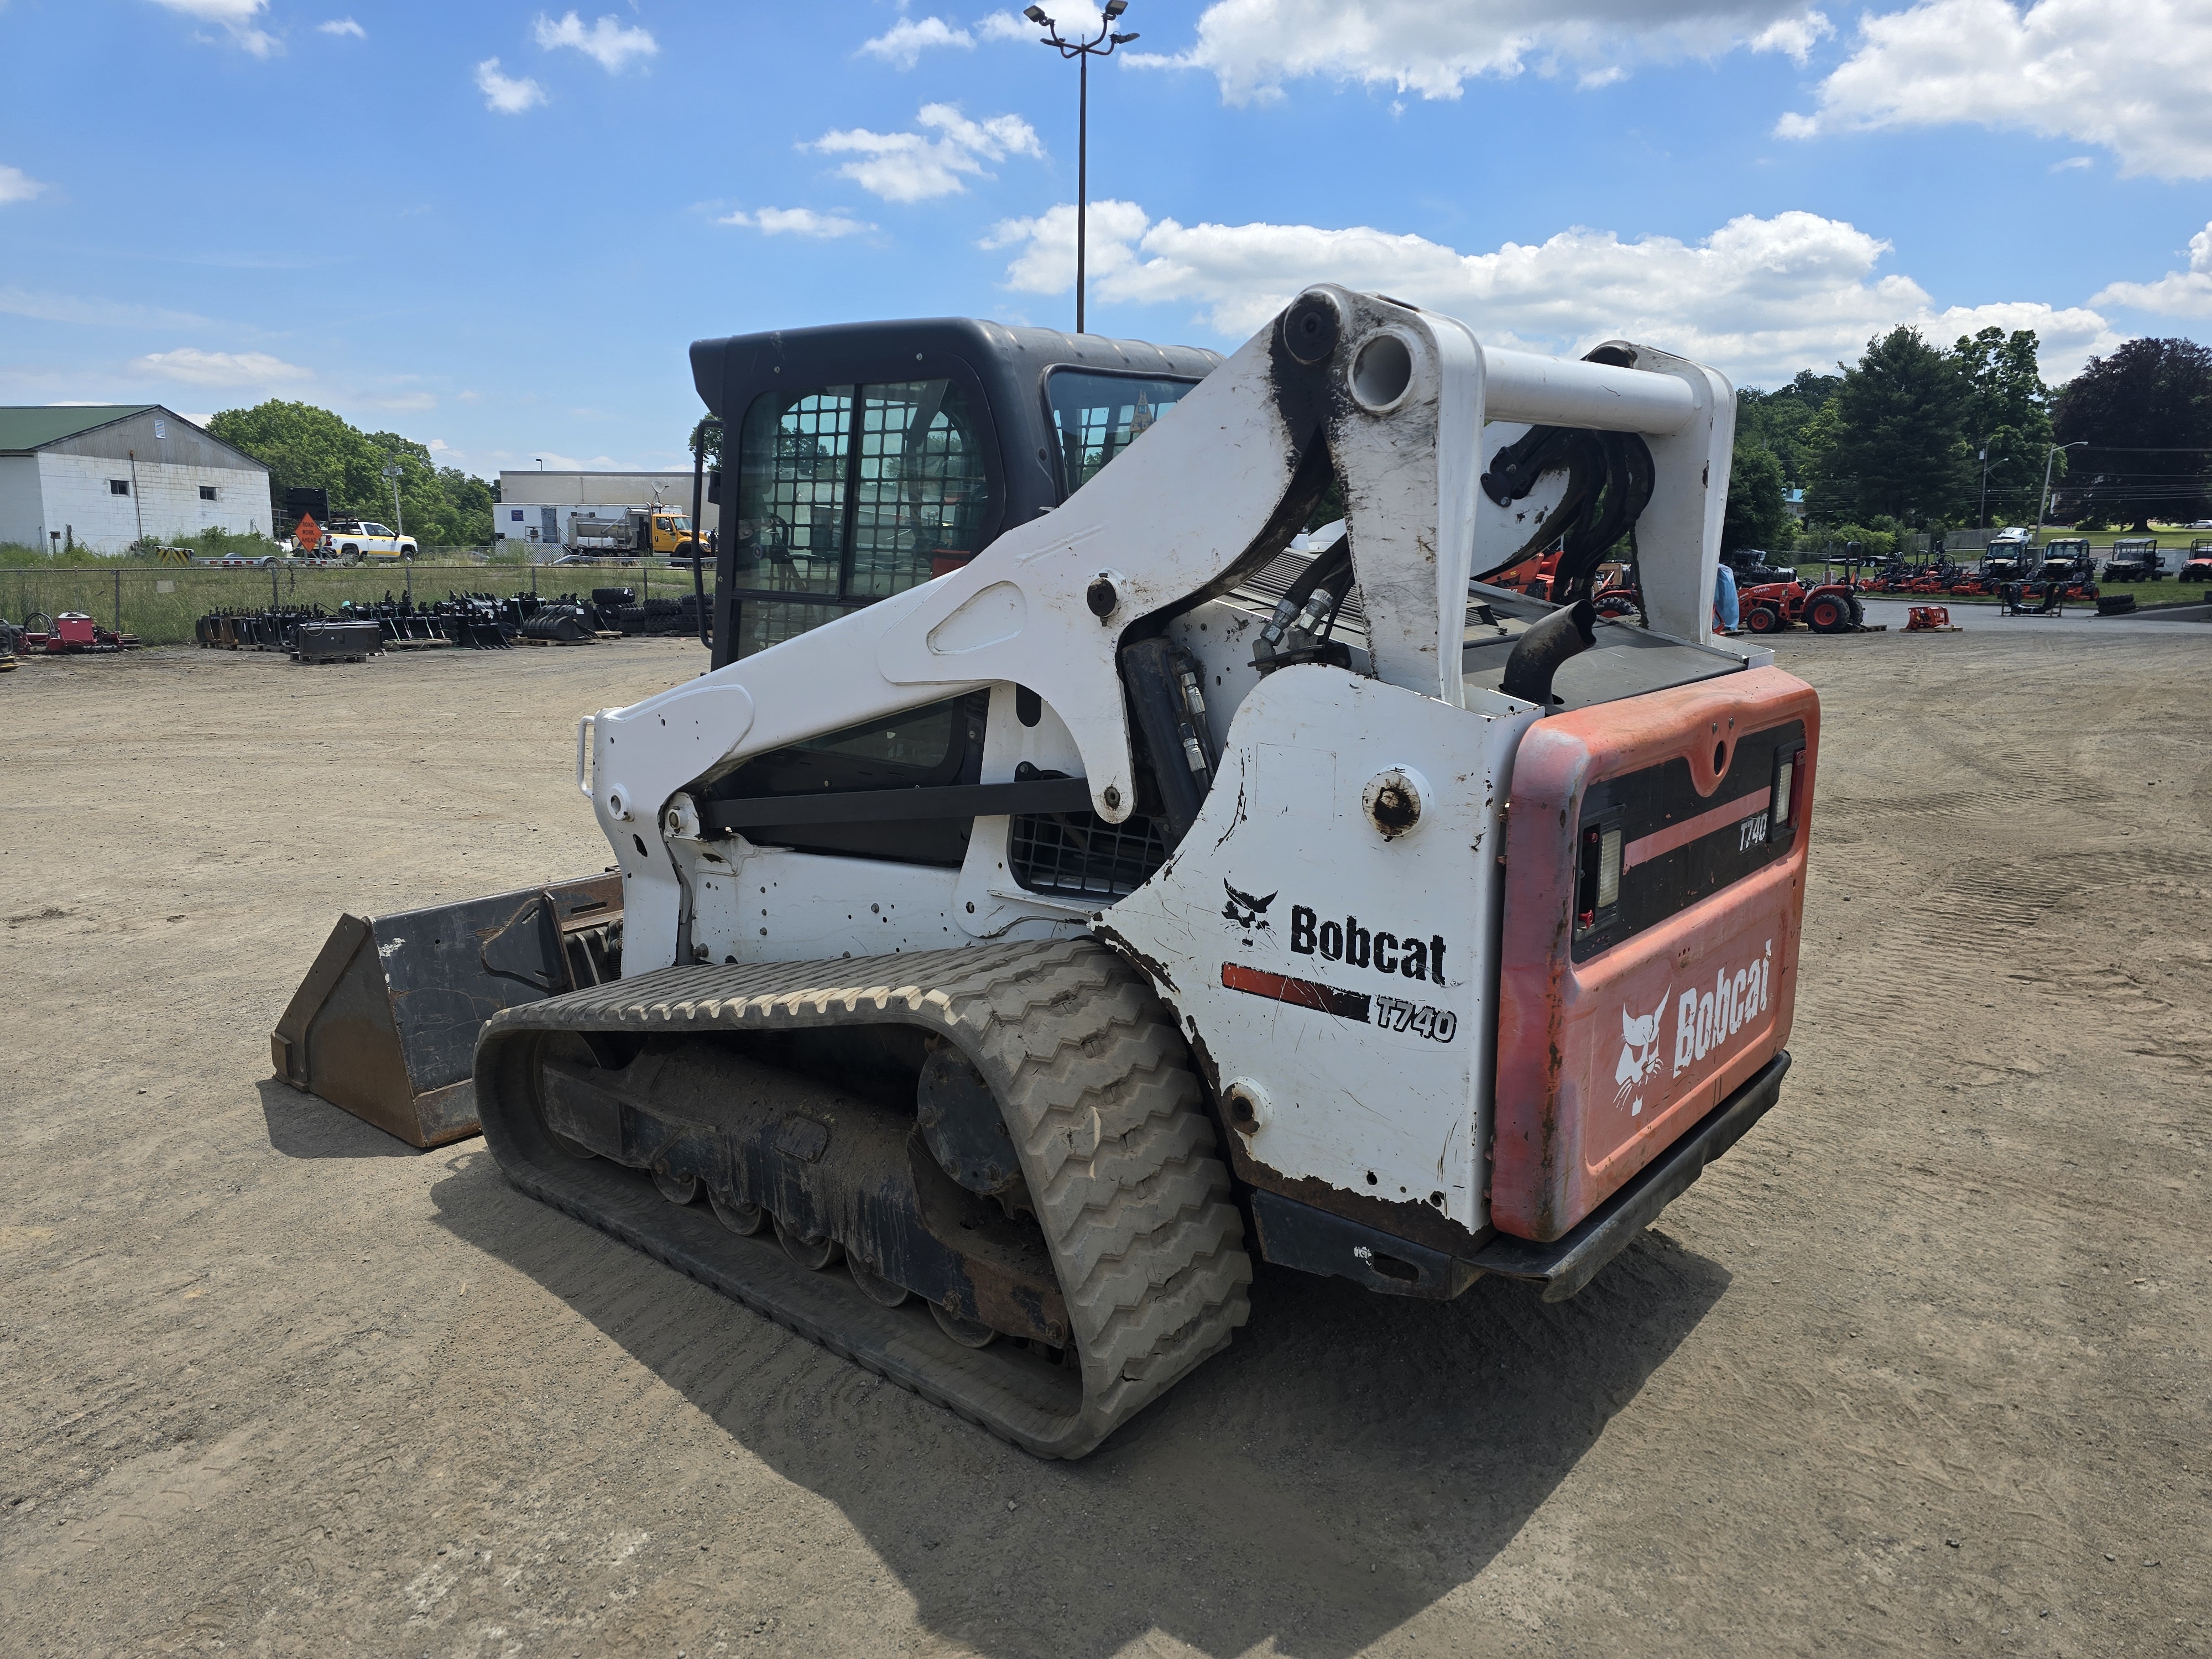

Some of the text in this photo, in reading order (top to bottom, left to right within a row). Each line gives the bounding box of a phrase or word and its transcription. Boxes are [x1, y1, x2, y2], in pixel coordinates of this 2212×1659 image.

[1740, 813, 1767, 851] T740
[1291, 904, 1446, 985] Bobcat
[1377, 995, 1457, 1044] T740
[1673, 938, 1772, 1079] Bobcat
